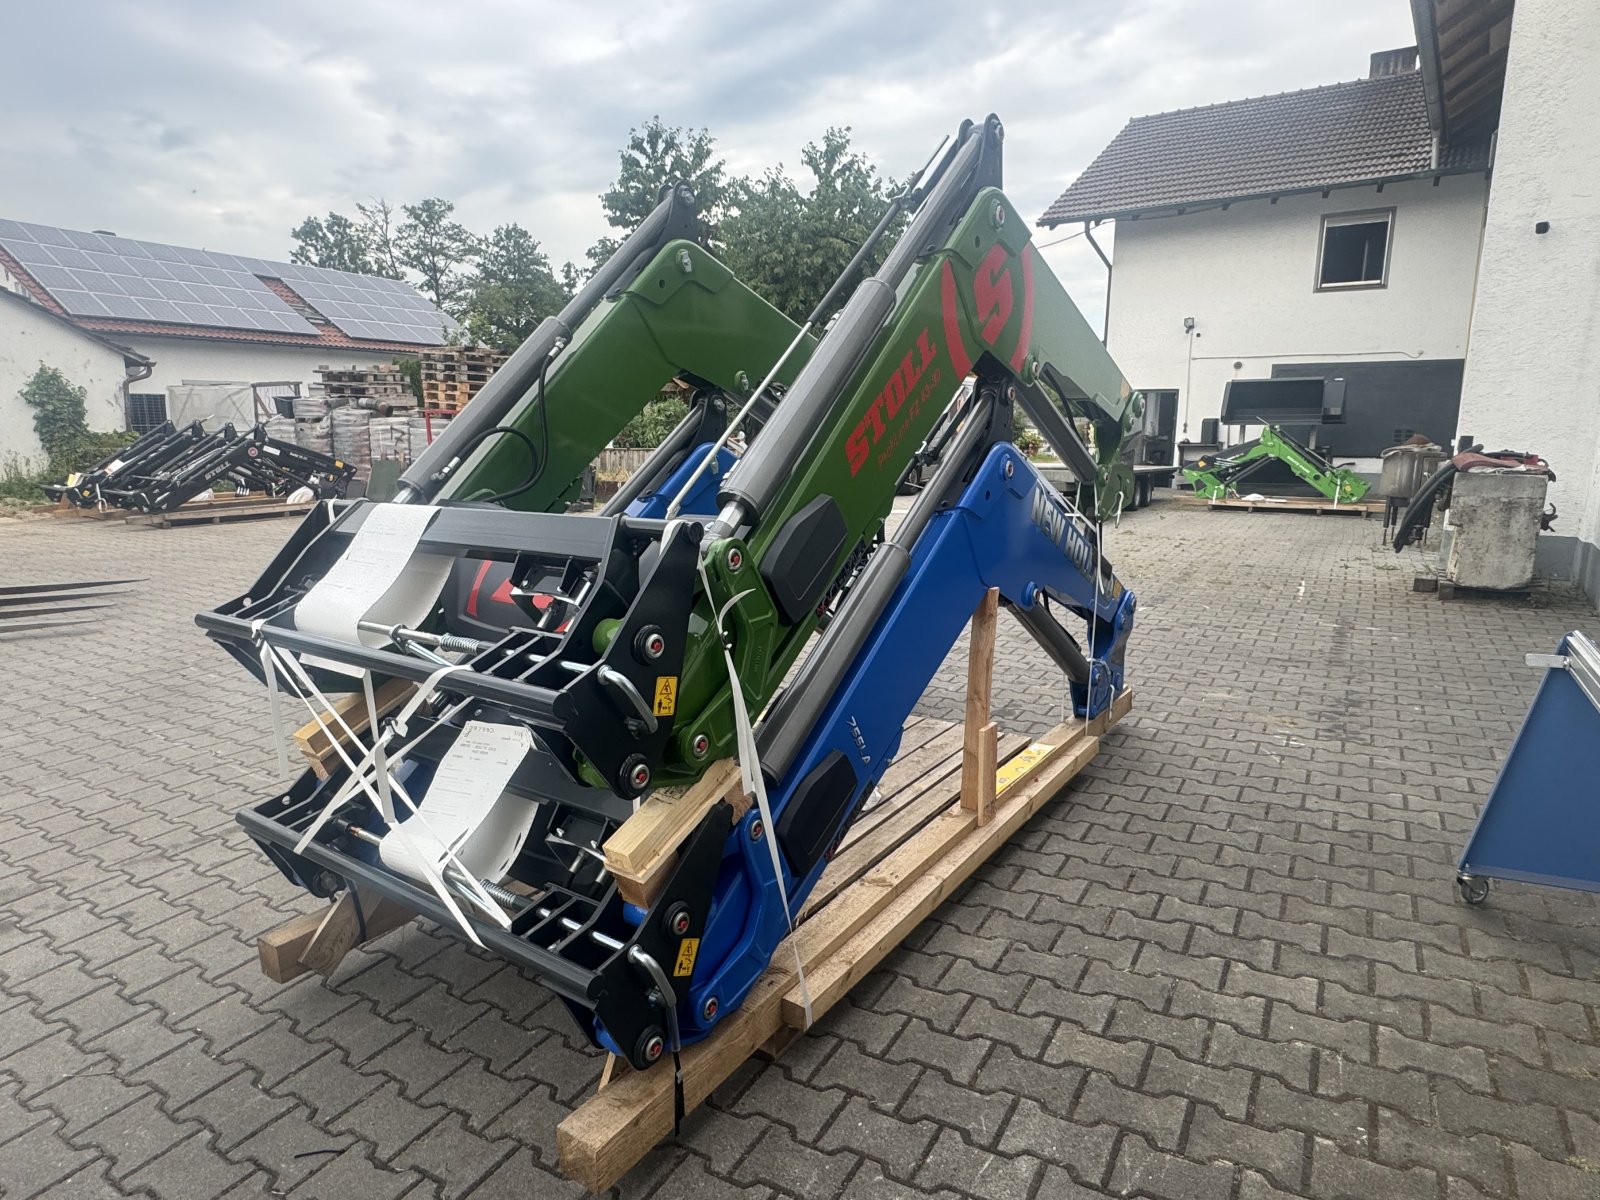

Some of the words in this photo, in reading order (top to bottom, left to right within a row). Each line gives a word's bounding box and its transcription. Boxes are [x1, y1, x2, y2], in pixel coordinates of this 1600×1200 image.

[845, 326, 937, 477] STOLL
[204, 461, 232, 481] STOLL
[1030, 486, 1066, 548] NEW
